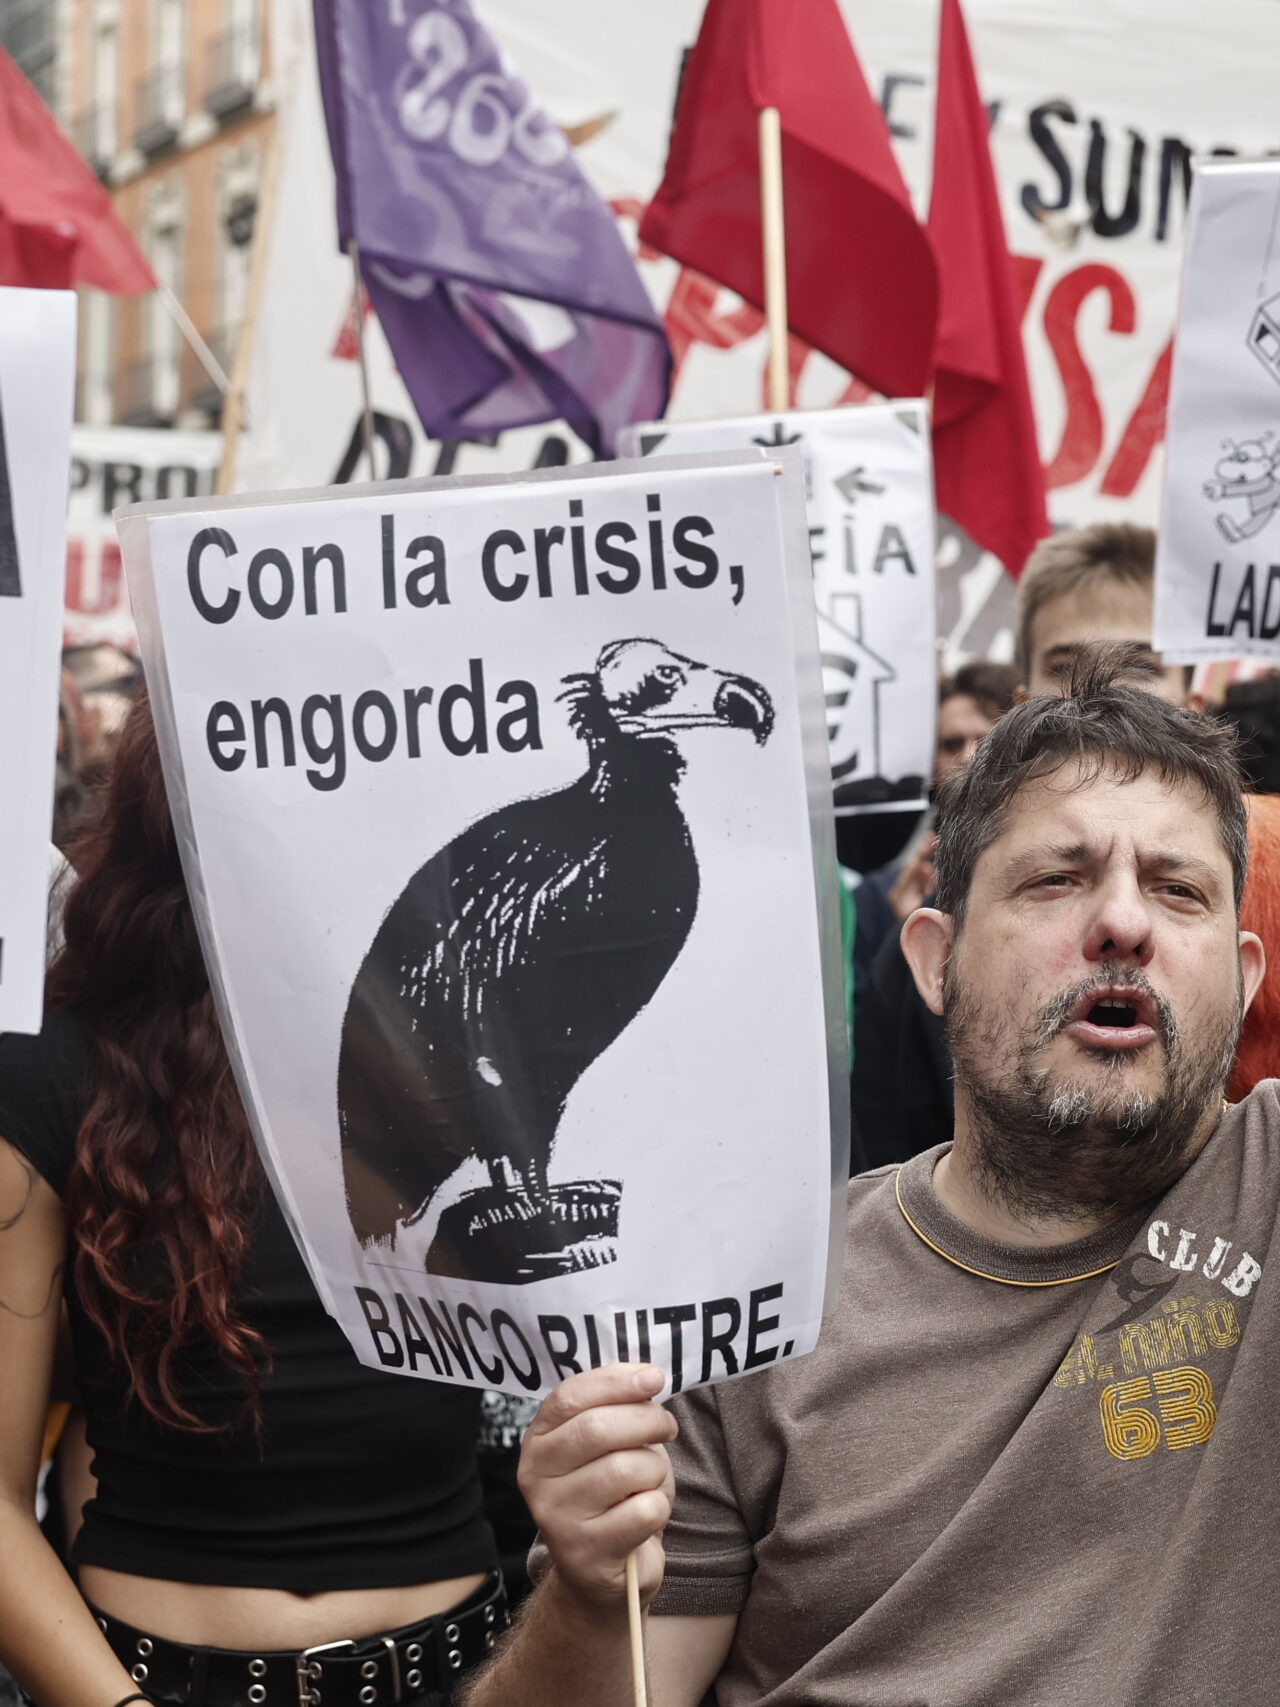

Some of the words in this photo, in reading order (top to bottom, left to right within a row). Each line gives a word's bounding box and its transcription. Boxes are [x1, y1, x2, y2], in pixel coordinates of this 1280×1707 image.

[186, 526, 347, 625] Con
[381, 513, 448, 609] la
[481, 493, 746, 607] crisis,
[205, 657, 544, 793] engorda
[1147, 1219, 1263, 1298] CLUB
[354, 1285, 542, 1391] BANCO
[537, 1281, 796, 1396] BUITRE.
[1099, 1366, 1219, 1461] 63
